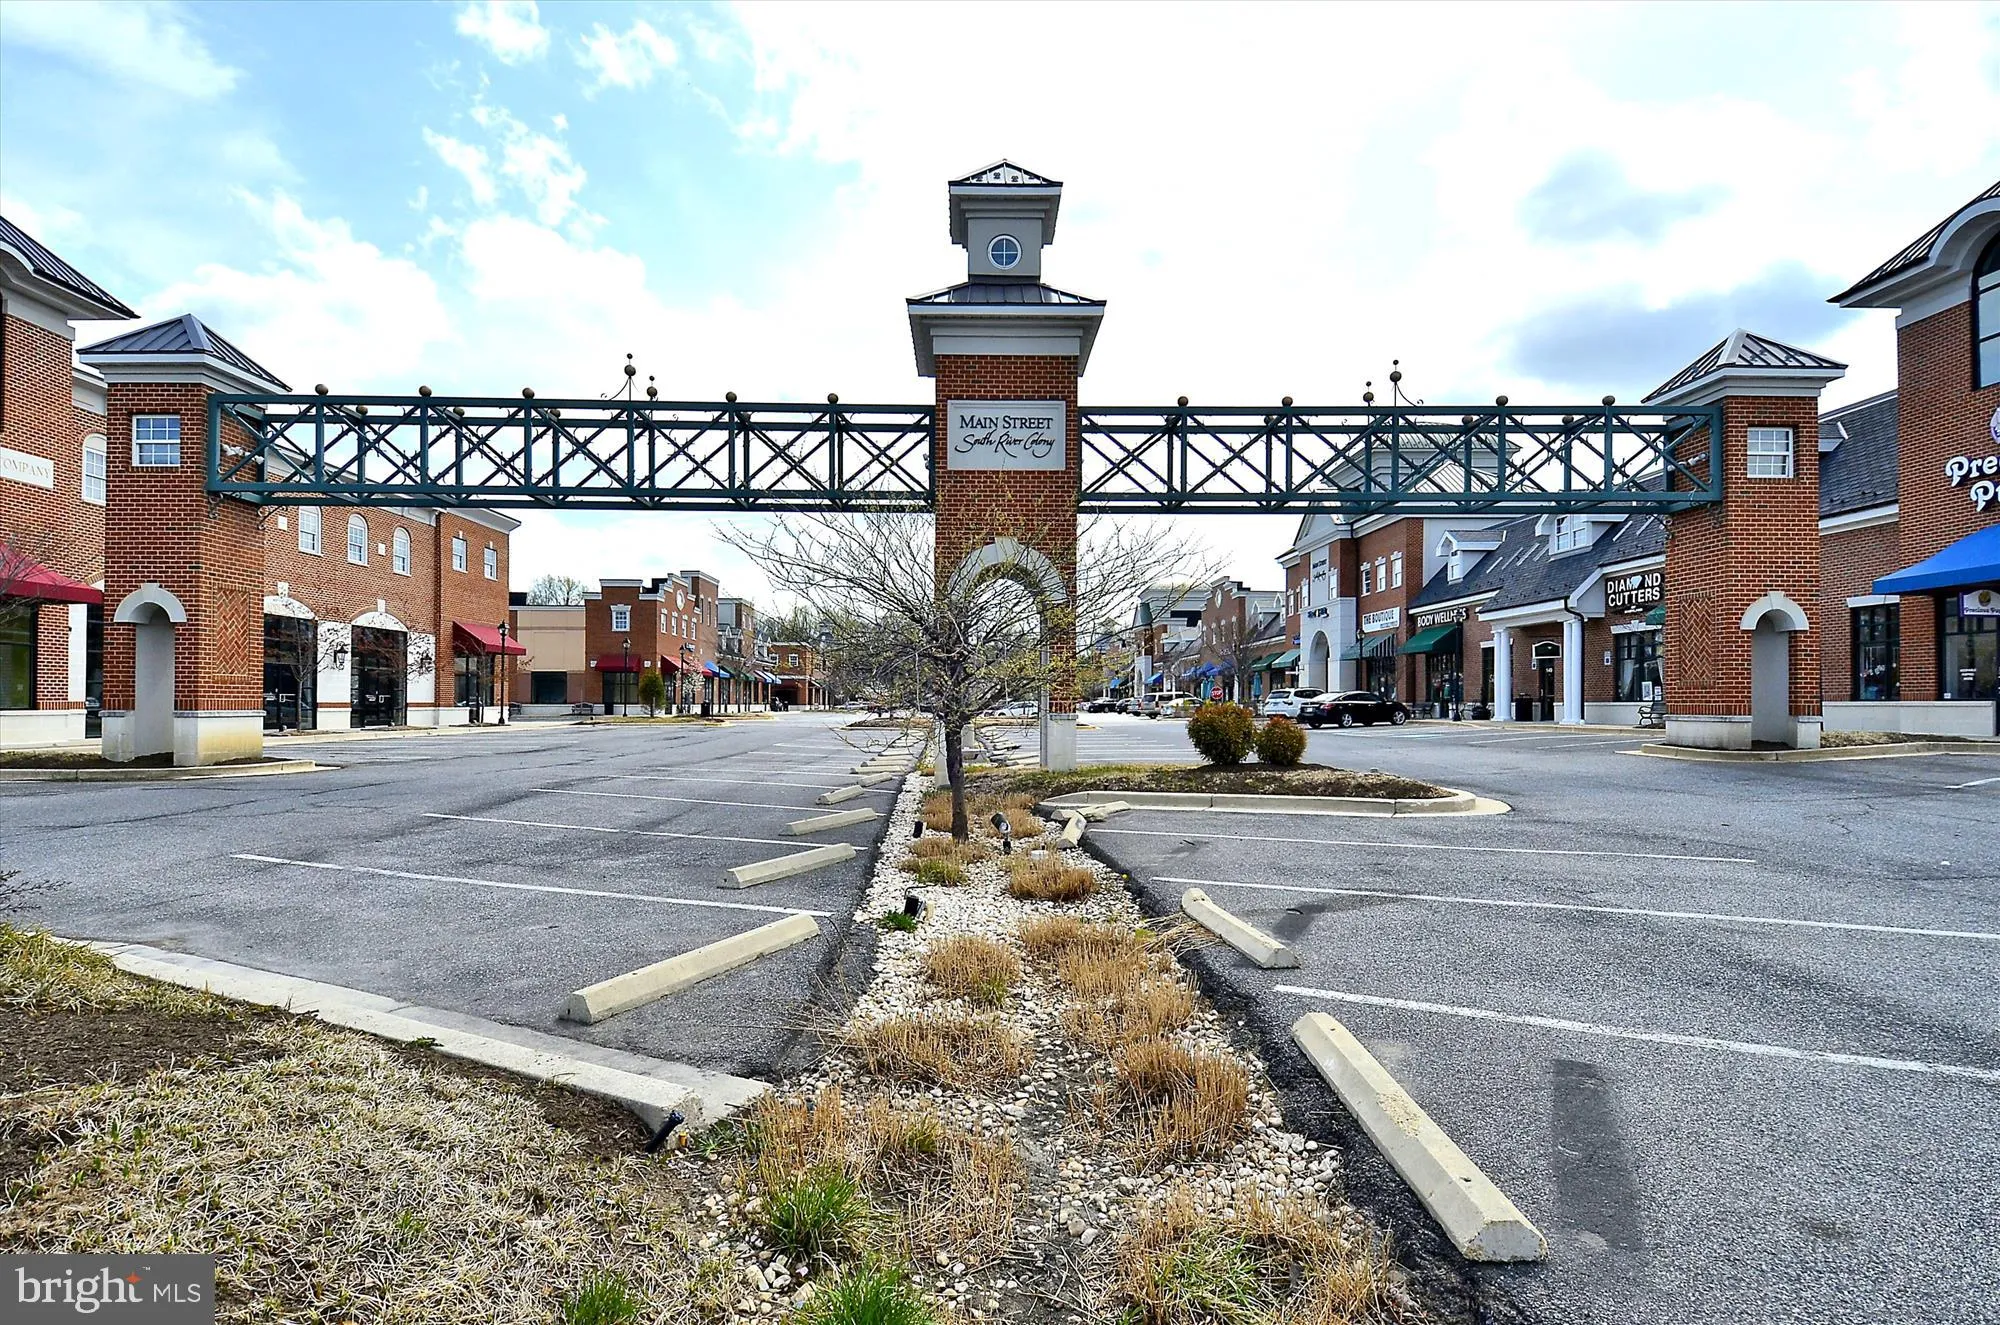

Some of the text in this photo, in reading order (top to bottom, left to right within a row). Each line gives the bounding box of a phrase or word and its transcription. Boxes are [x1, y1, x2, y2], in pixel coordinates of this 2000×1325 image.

[960, 415, 1053, 429] MAIN STREET
[954, 429, 1056, 459] South River Colony
[1945, 456, 2000, 487] Pre
[1608, 587, 1661, 606] CUTTERS
[1373, 609, 1394, 623] BOUTIQUE
[1417, 613, 1434, 627] BODY
